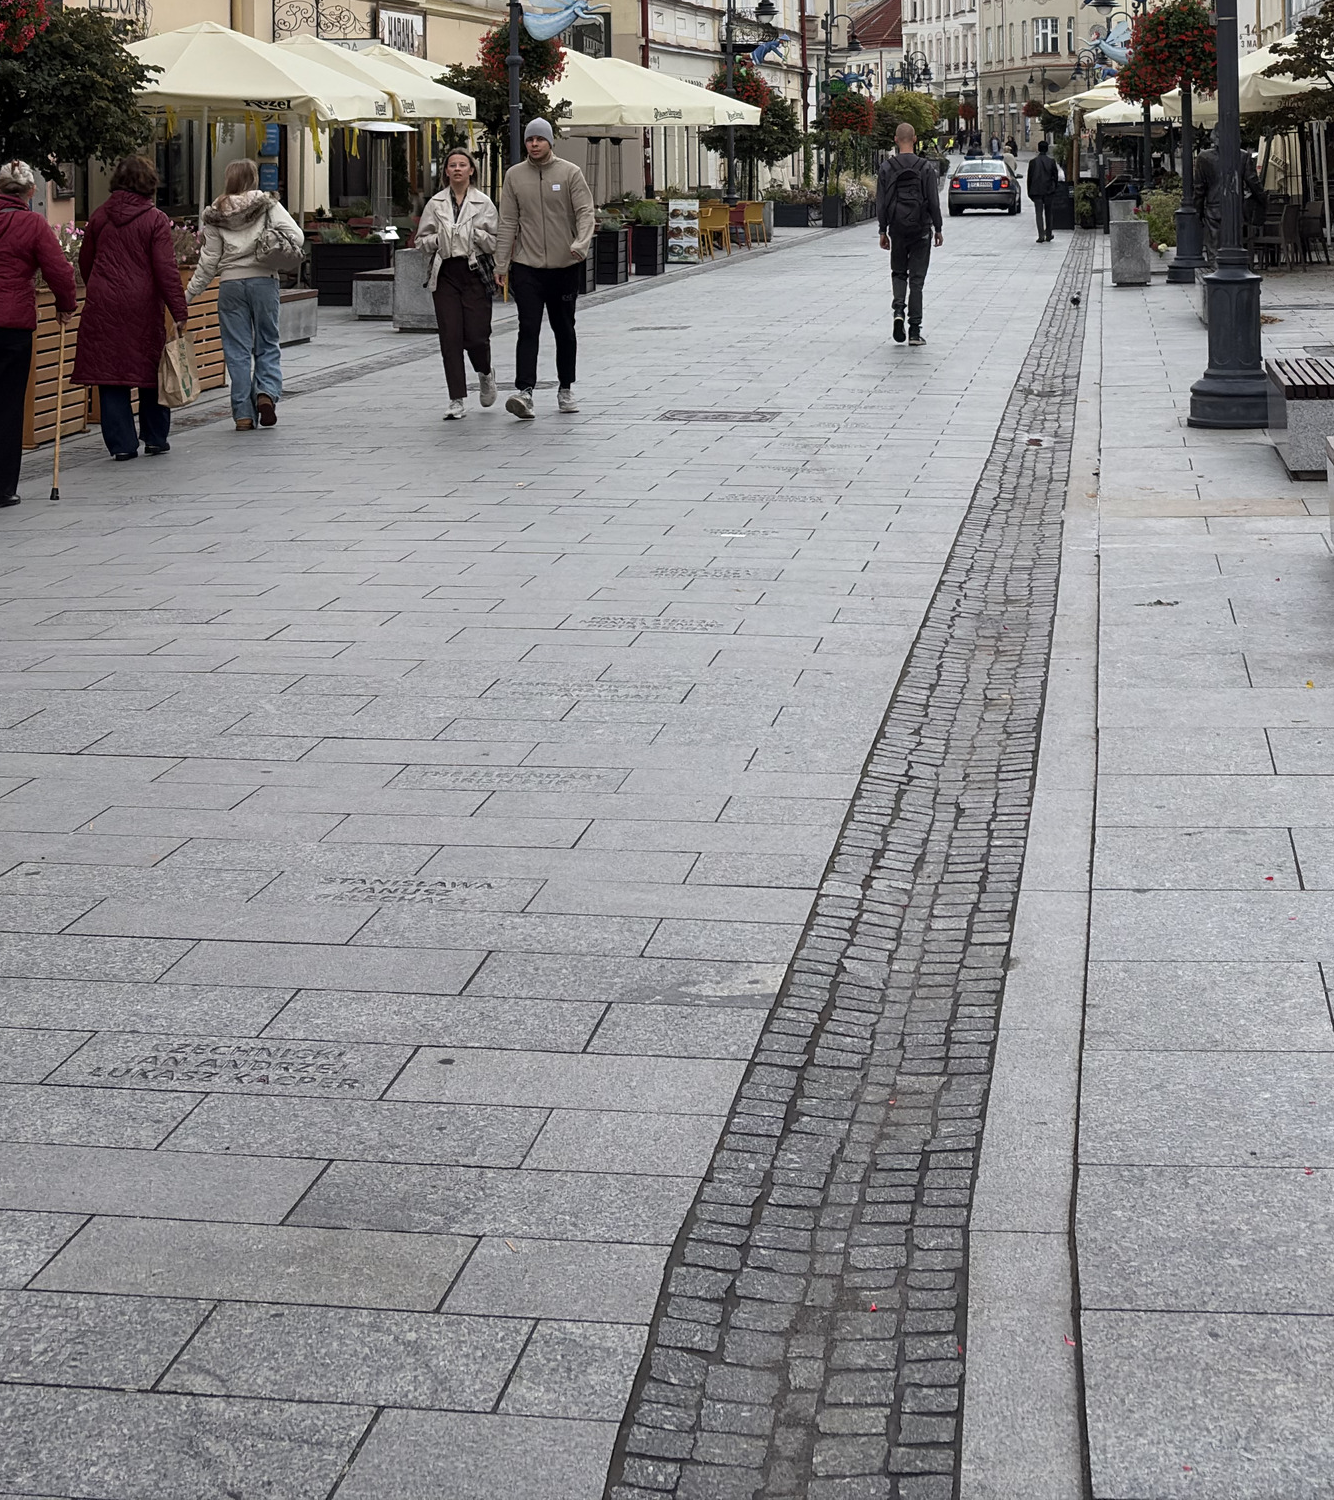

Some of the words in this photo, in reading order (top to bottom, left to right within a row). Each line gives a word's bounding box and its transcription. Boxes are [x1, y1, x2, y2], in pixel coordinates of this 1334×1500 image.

[346, 887, 453, 897] JANUSZ
[152, 1043, 346, 1060] CZECHNICKI
[123, 1054, 188, 1067] JAN
[195, 1058, 349, 1075] ANDRZEJ
[88, 1066, 220, 1082] ŁUKASZ
[229, 1071, 365, 1089] KACPER
